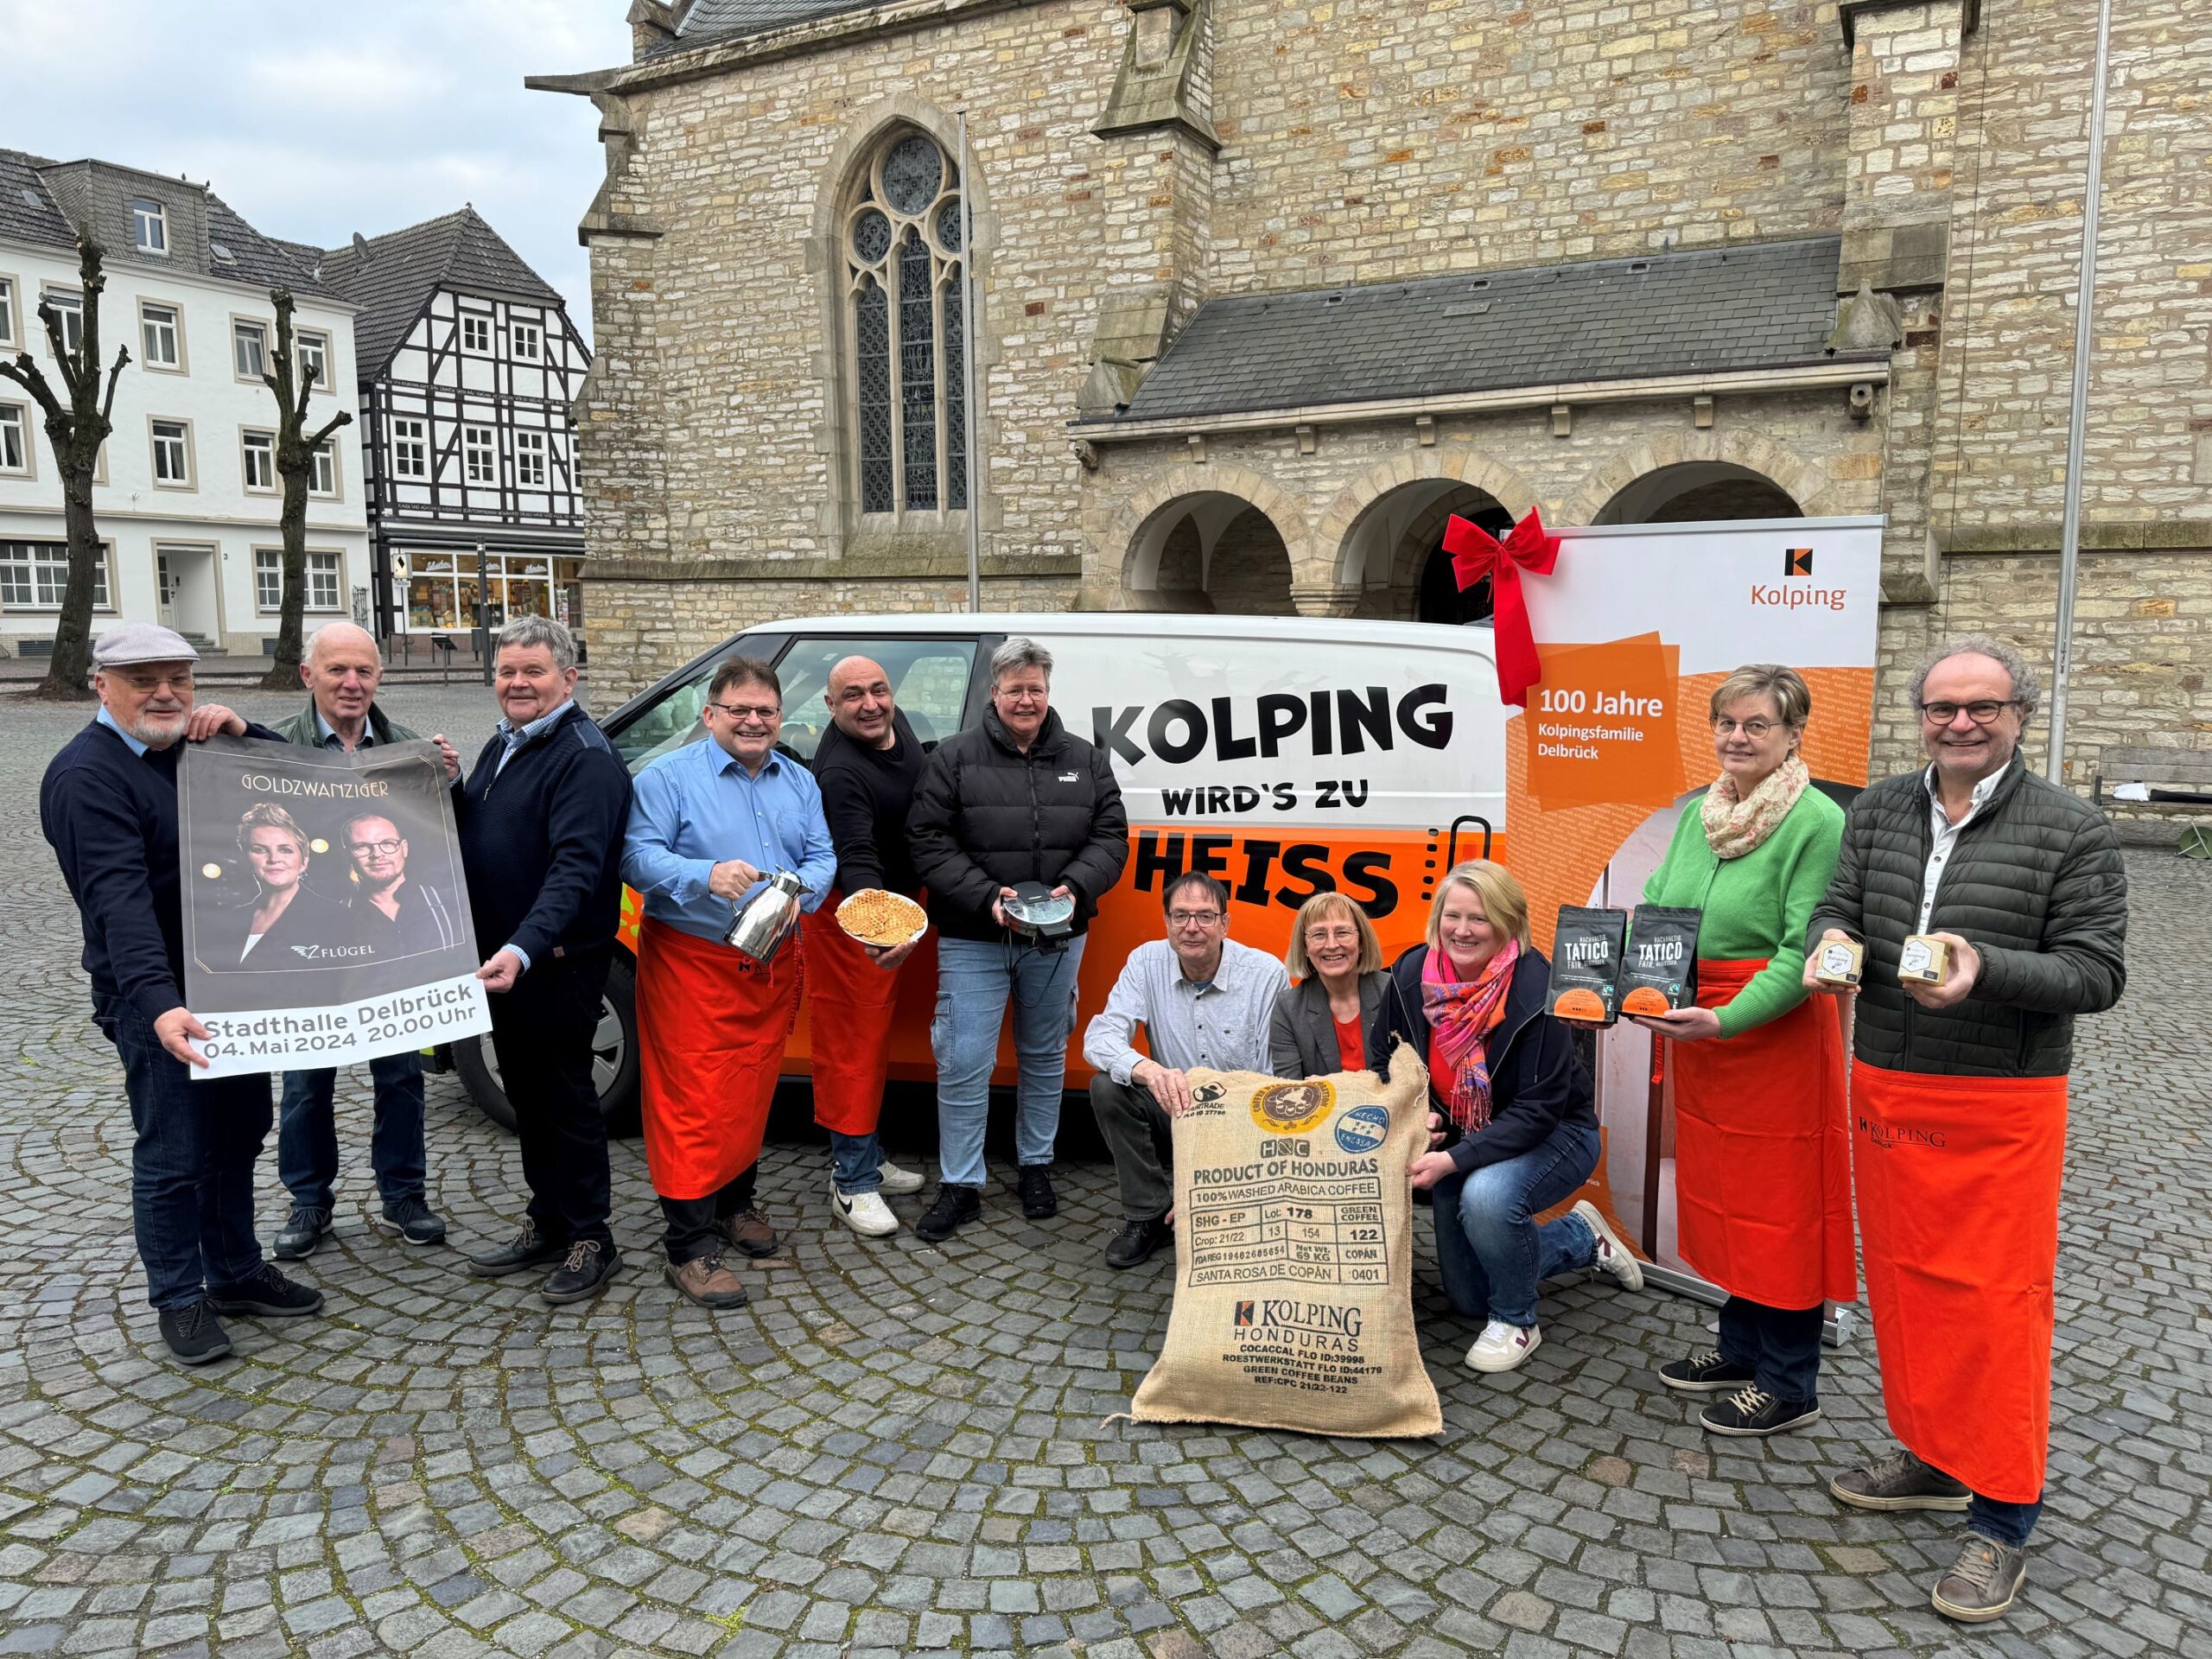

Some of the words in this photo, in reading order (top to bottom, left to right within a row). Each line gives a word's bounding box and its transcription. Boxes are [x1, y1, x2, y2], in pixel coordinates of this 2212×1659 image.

[1751, 584, 1847, 611] Kolping
[1540, 690, 1586, 714] 100
[1592, 690, 1663, 718] Jahre
[1092, 683, 1453, 766] KOLPING
[1538, 722, 1643, 742] Kolpingsfamilie
[1538, 743, 1599, 761] Delbrück
[242, 773, 389, 798] GOLDZWANZIGER
[1161, 782, 1298, 816] WIRD'S
[1315, 779, 1369, 810] ZU
[1134, 830, 1399, 919] HEISS
[1565, 941, 1609, 962] TATICO
[1638, 941, 1683, 962] TATICO
[204, 1014, 348, 1039] Stadthalle
[358, 983, 474, 1025] Delbrück
[204, 1042, 245, 1059] 04.
[251, 1036, 289, 1056] Mai
[295, 1033, 357, 1052] 2024
[368, 1014, 434, 1044] 20.00
[438, 1005, 476, 1026] Uhr
[1355, 1111, 1385, 1124] HECHO
[1870, 1122, 1947, 1147] KOLPING
[1193, 1163, 1264, 1185] PRODUCT
[1267, 1160, 1287, 1176] OF
[1291, 1158, 1378, 1177] HONDURAS
[1196, 1192, 1228, 1203] 100%
[1228, 1185, 1275, 1200] WASHED
[1278, 1182, 1326, 1196] ARABICA
[1328, 1182, 1376, 1196] COFFEE
[1195, 1215, 1220, 1227] SHG
[1230, 1212, 1246, 1224] EP
[1287, 1207, 1313, 1218] 178
[1195, 1236, 1217, 1246] Crop:
[1219, 1232, 1244, 1243] 21/22
[1268, 1226, 1281, 1237] 13
[1302, 1228, 1320, 1238] 154
[1350, 1230, 1378, 1240] 122
[1296, 1252, 1310, 1261] 69
[1313, 1253, 1331, 1262] KG
[1197, 1268, 1232, 1282] SANTA
[1234, 1266, 1268, 1279] ROSA
[1269, 1264, 1286, 1276] DE
[1351, 1268, 1379, 1280] 0401
[1262, 1300, 1363, 1338] KOLPING
[1234, 1328, 1359, 1352] HONDURAS
[1240, 1344, 1294, 1357] COCACCAL
[1298, 1350, 1318, 1360] FLO
[1223, 1354, 1315, 1371] ROESTWERKSTATT
[1319, 1363, 1337, 1373] FLO
[1243, 1365, 1279, 1375] GREEN
[1281, 1369, 1320, 1382] COFFEE
[1324, 1374, 1358, 1384] BEANS
